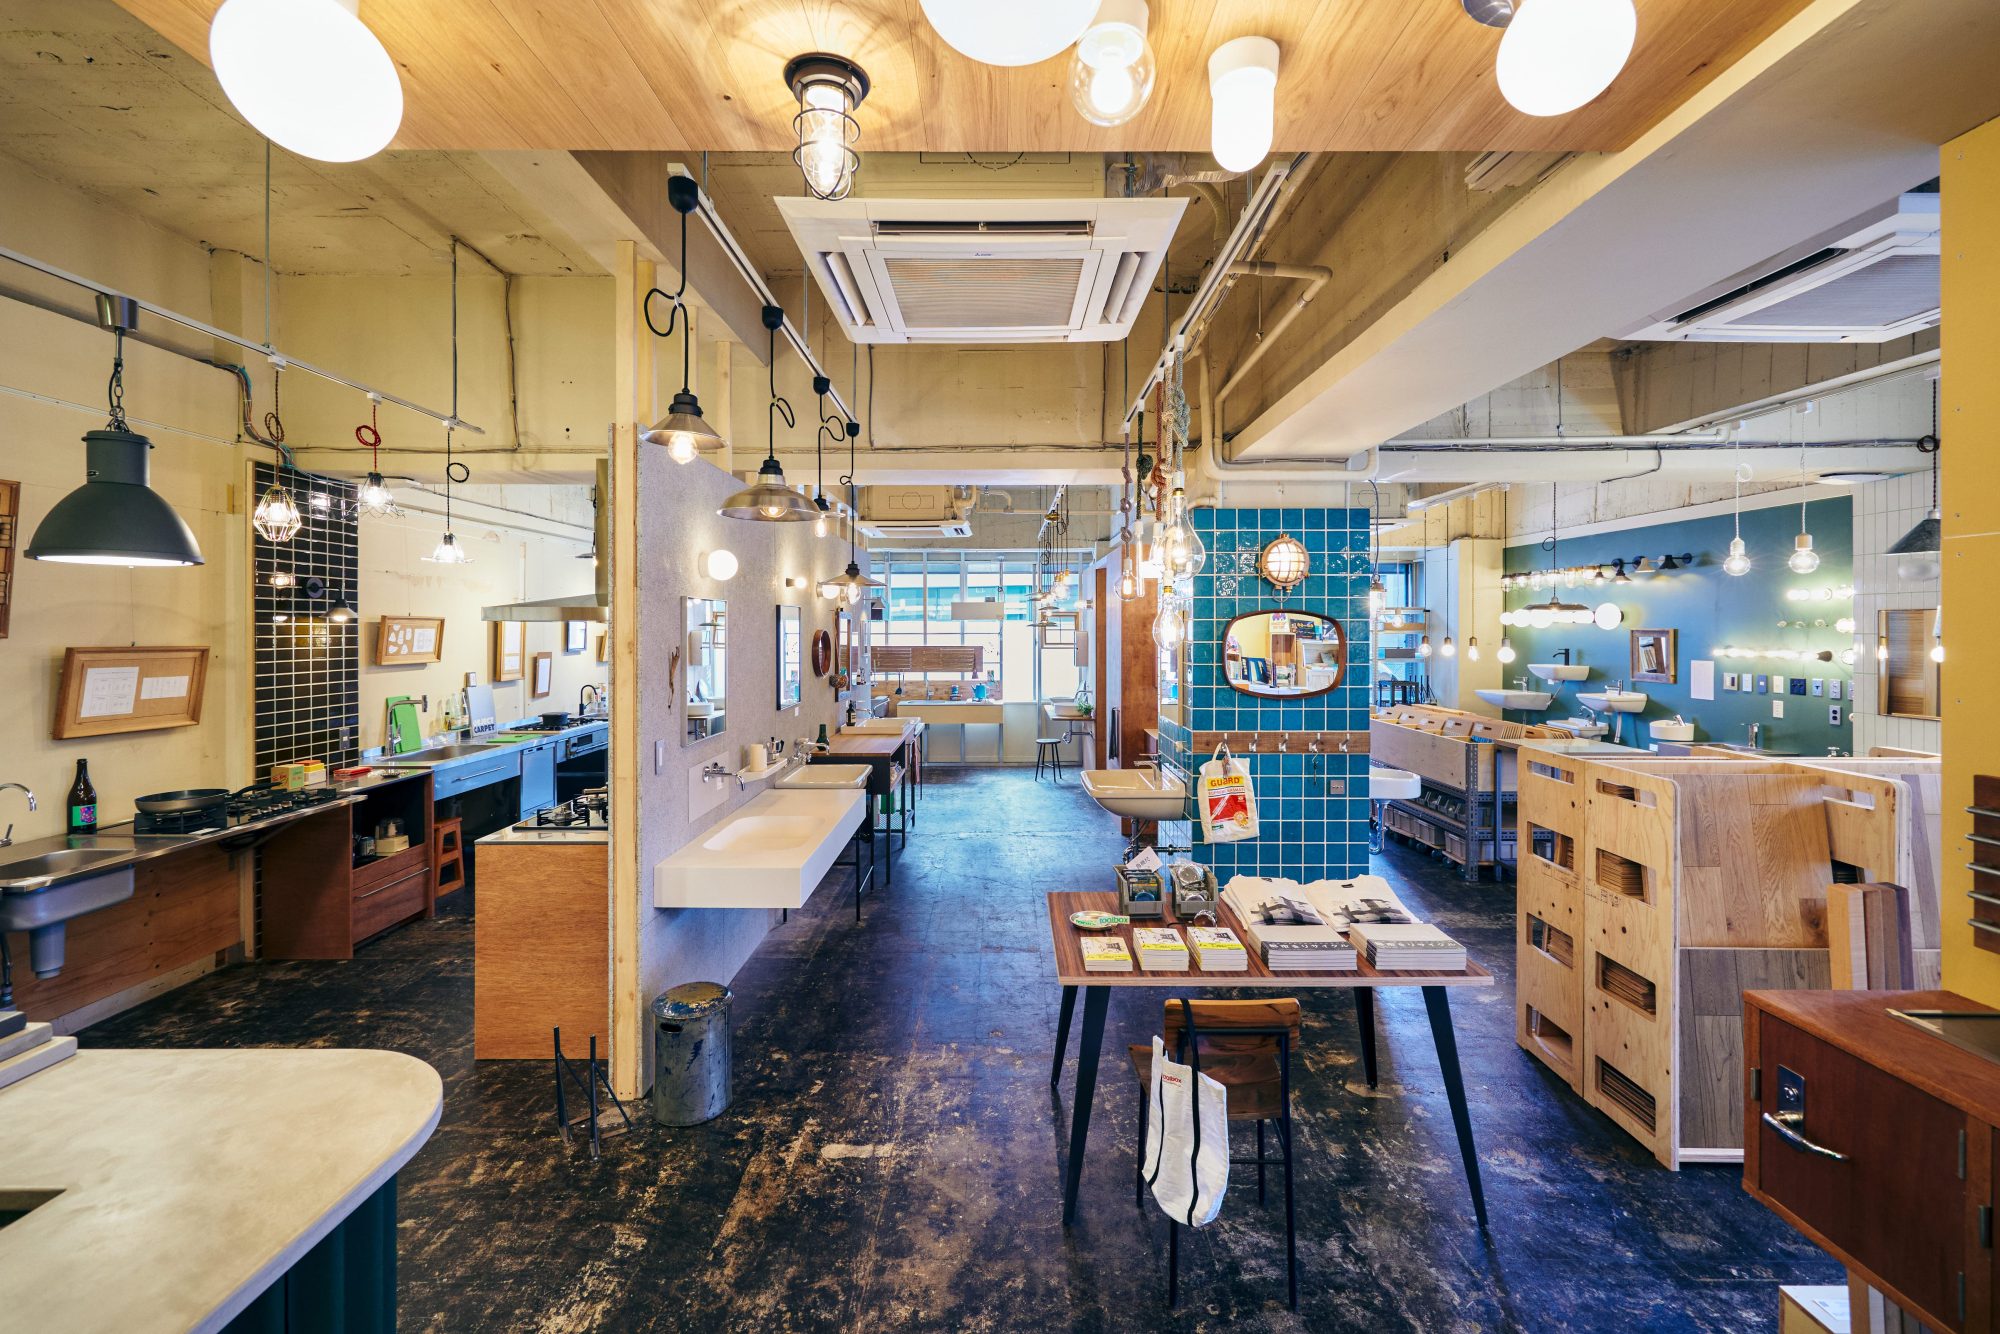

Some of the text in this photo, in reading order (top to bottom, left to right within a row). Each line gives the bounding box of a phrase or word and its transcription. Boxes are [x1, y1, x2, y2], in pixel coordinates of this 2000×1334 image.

[474, 723, 495, 734] CARPET
[1099, 916, 1128, 924] toolbox
[1162, 1074, 1182, 1083] oolbox
